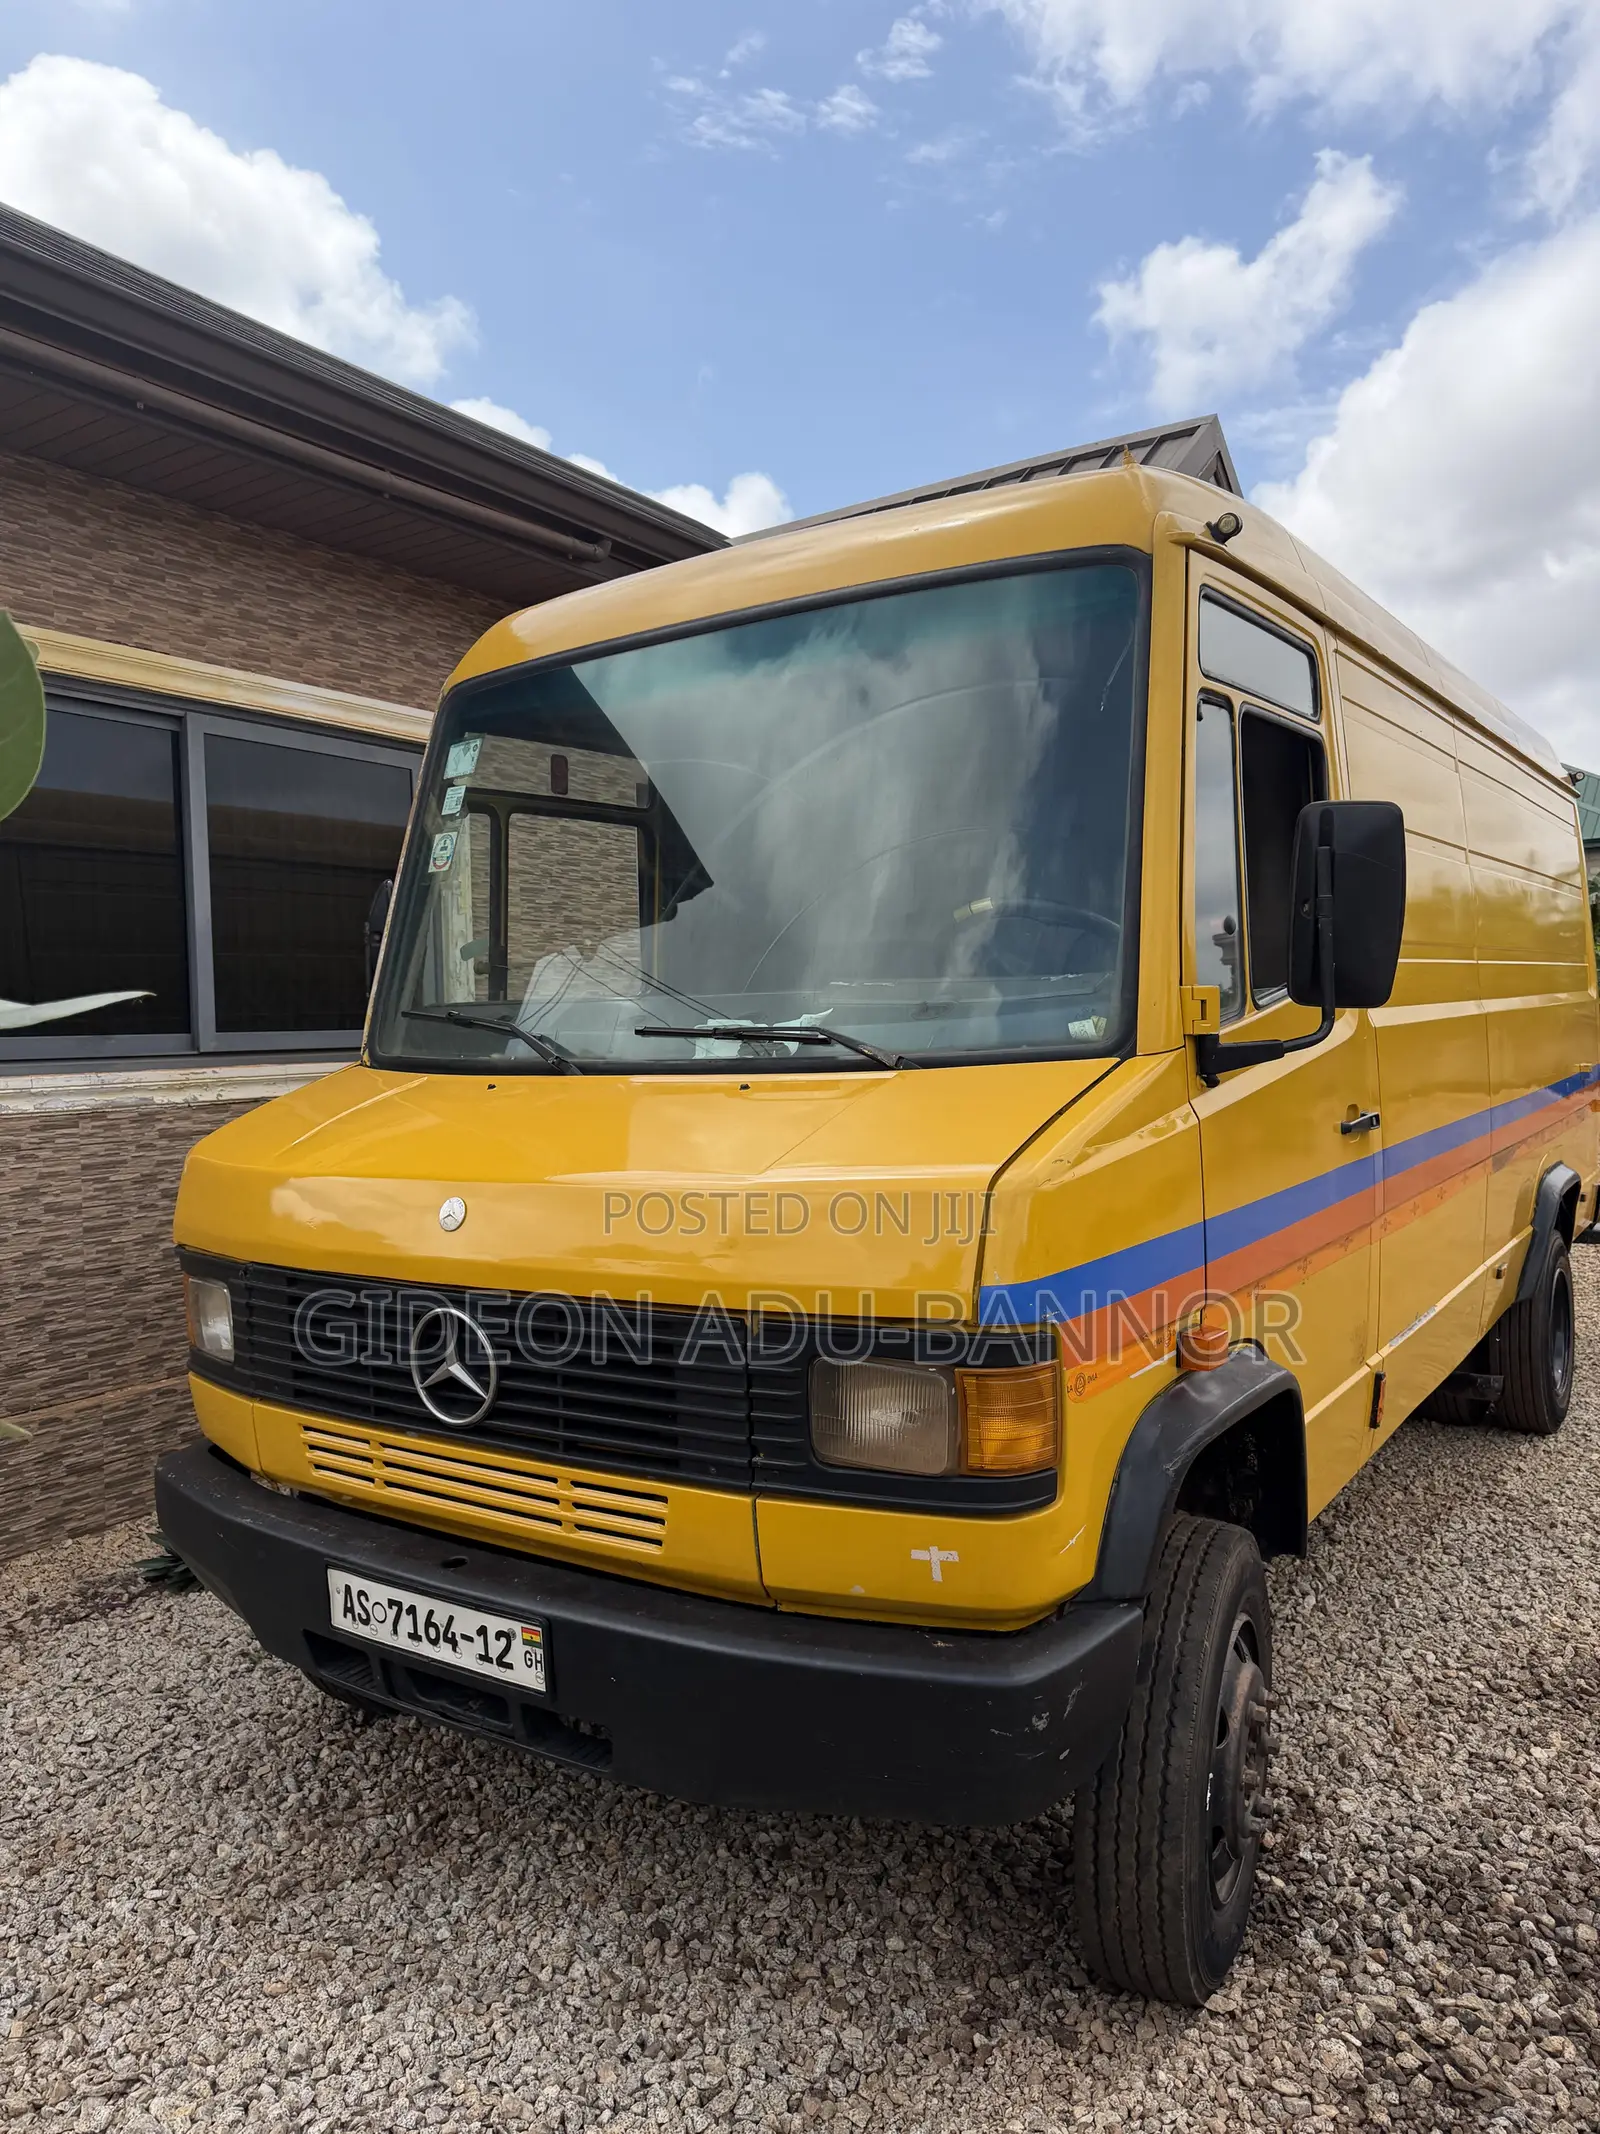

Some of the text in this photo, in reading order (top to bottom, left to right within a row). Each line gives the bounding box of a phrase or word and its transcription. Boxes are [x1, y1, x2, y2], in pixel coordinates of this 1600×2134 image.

[343, 1584, 514, 1671] AS 7164-12
[523, 1649, 544, 1672] GH
